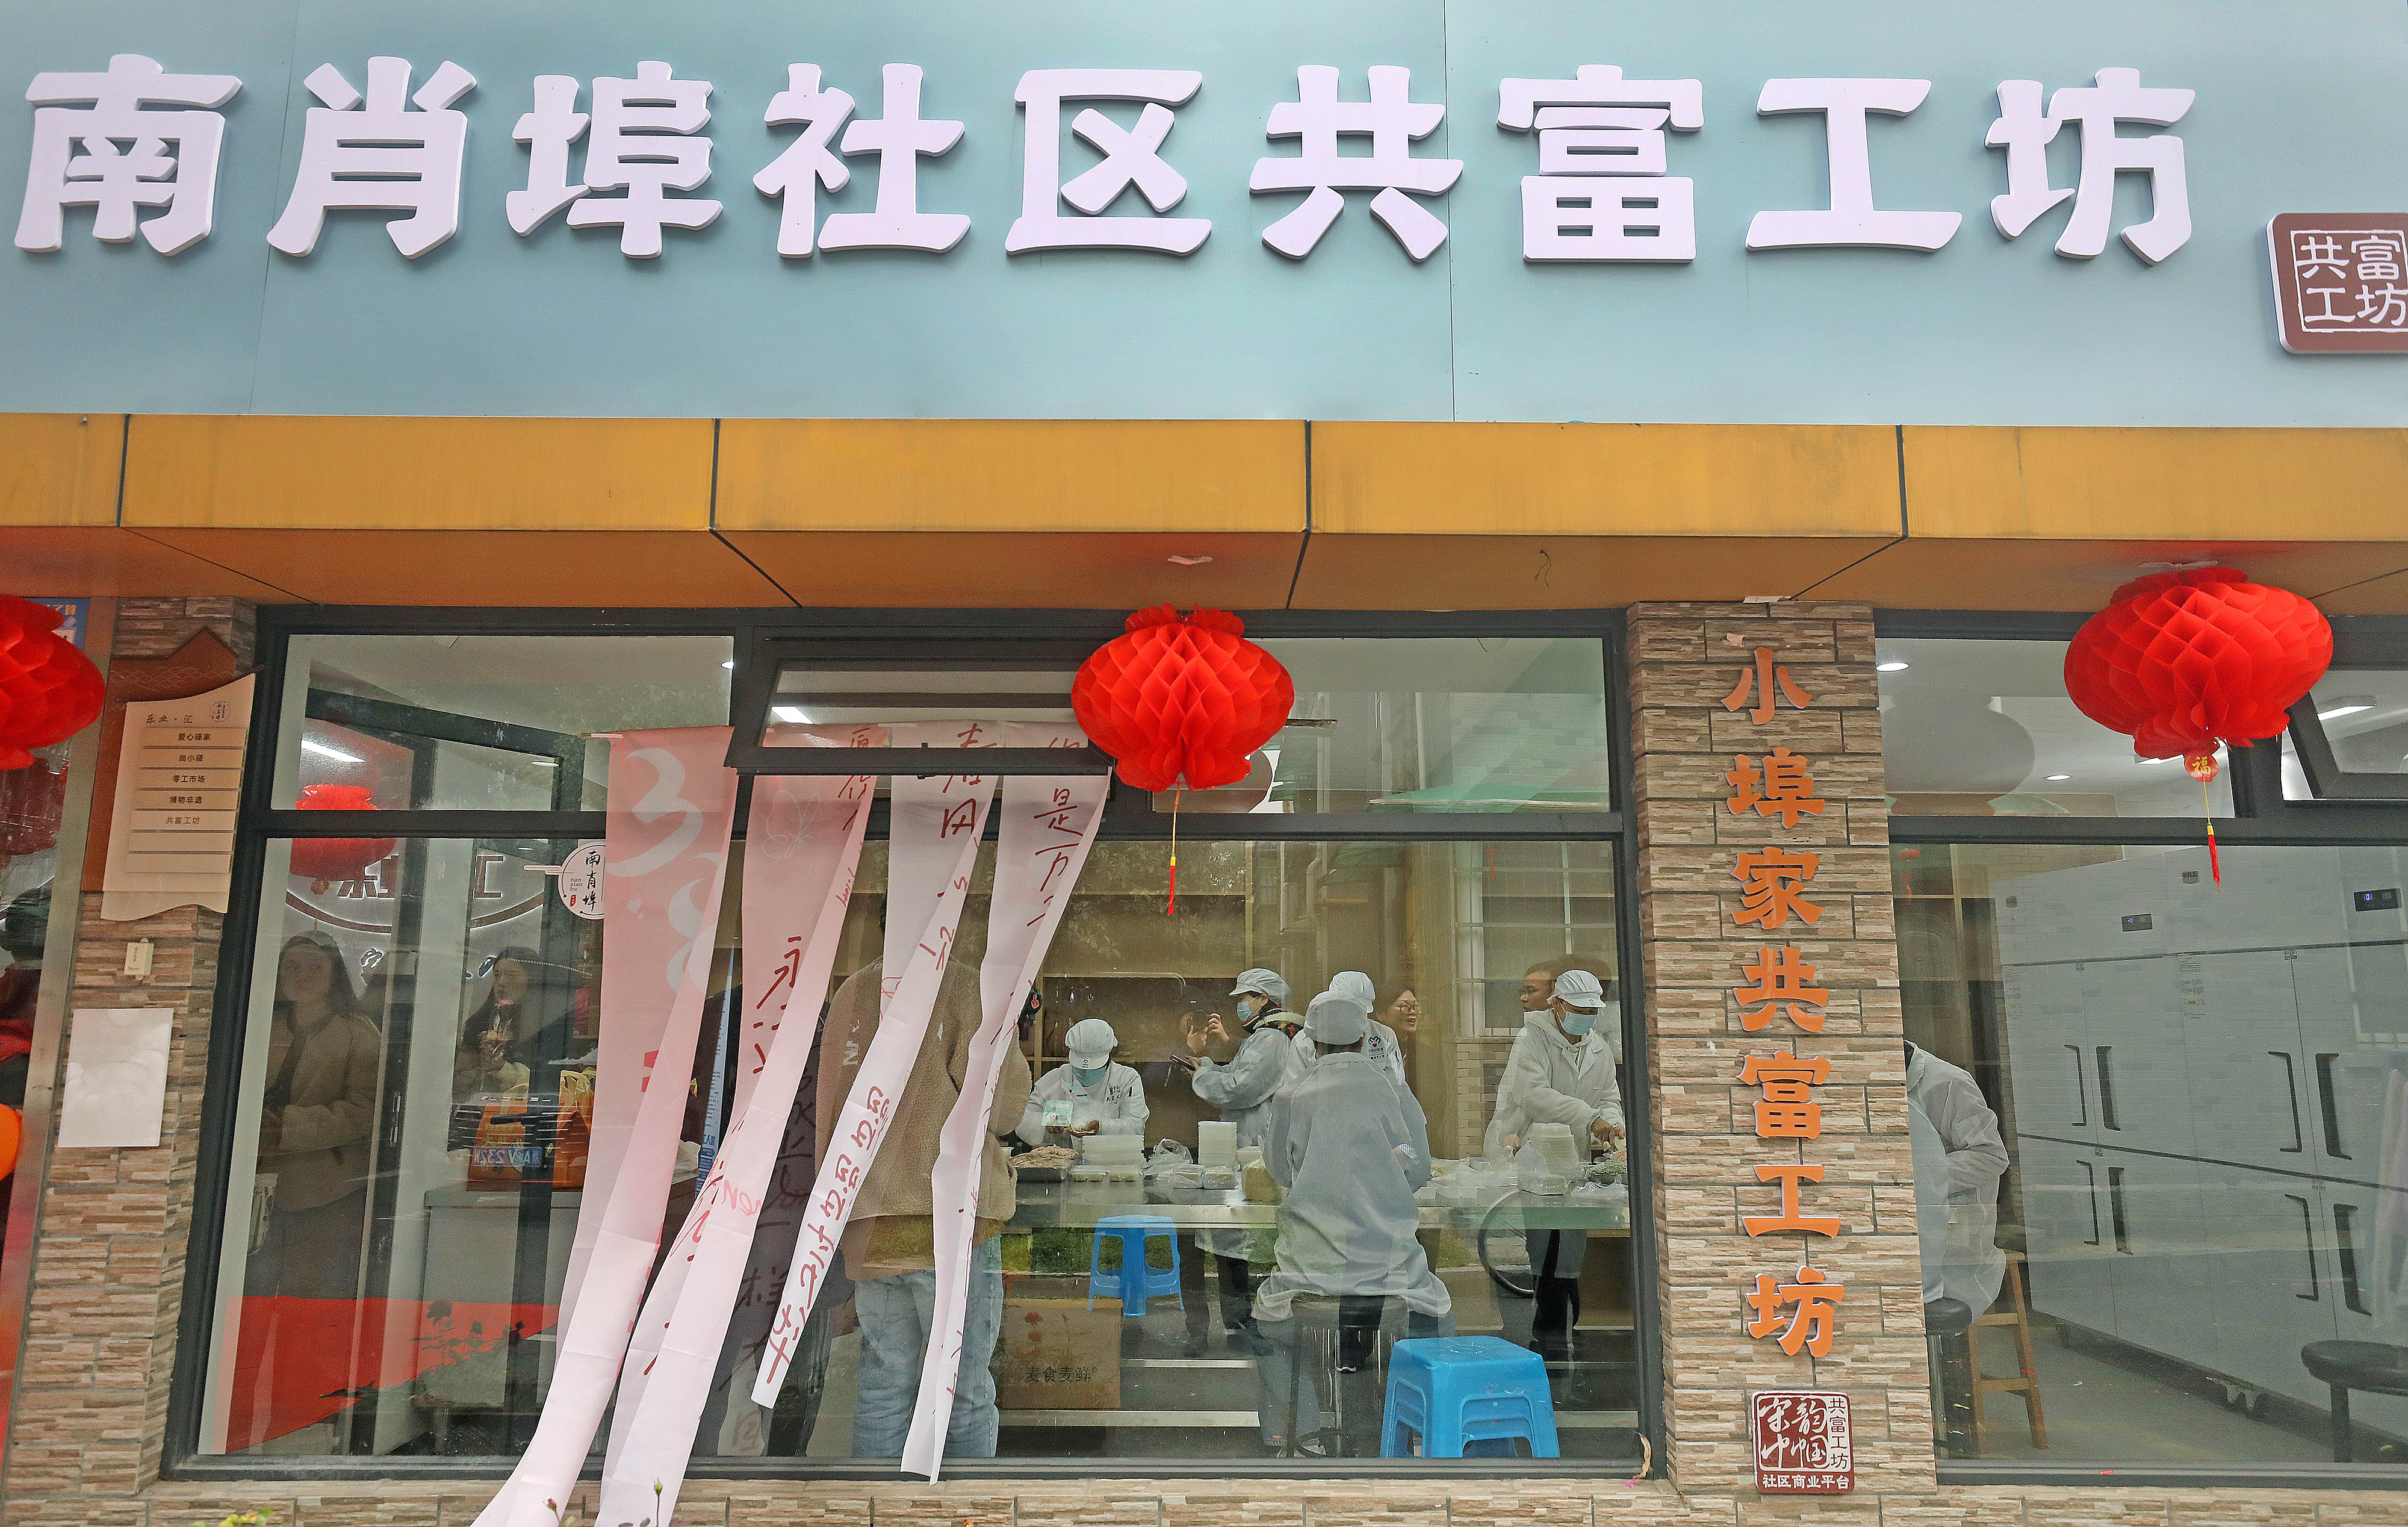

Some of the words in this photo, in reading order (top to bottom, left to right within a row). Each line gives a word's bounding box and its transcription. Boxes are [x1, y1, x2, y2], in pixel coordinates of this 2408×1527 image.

[14, 53, 2196, 266] 南肖埠社区共富工坊
[2296, 235, 2401, 281] 共富
[2304, 282, 2408, 326] 工坊
[178, 733, 211, 741] 爱心驿家
[172, 775, 205, 783] 零工市场
[2191, 756, 2211, 776] 福
[166, 816, 200, 825] 共富工坊
[582, 850, 601, 912] 南肖埠
[1721, 646, 1846, 1358] 小埠家共富工坊
[1025, 1366, 1091, 1382] 麦食麦鲜
[1828, 1398, 1849, 1469] 共富工坊
[1762, 1474, 1849, 1490] 社区商业平台
